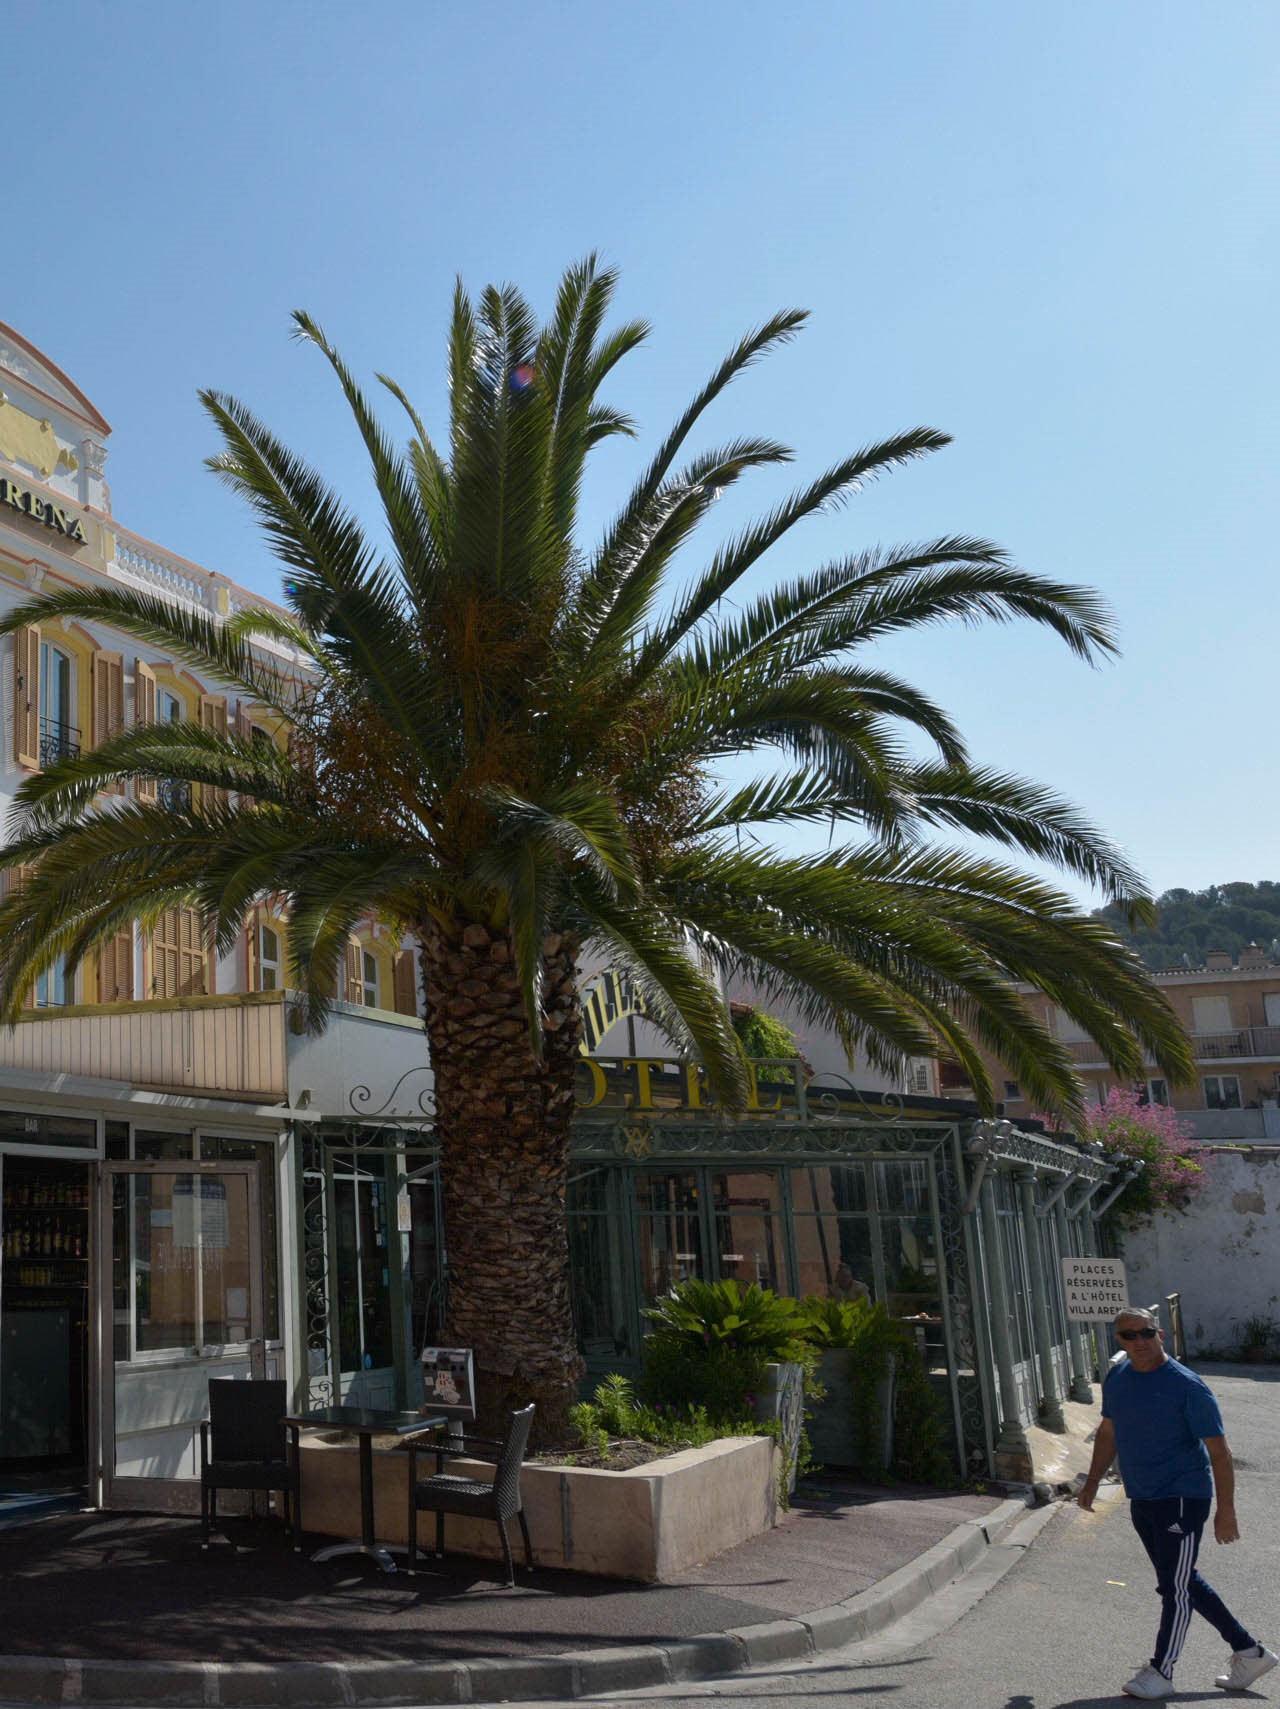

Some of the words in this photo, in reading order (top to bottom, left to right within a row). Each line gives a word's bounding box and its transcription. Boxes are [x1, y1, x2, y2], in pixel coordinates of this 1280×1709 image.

[575, 1057, 783, 1110] OTEL
[1073, 1265, 1114, 1274] PLACES
[1066, 1278, 1124, 1288] RÉSERVÉES
[1081, 1291, 1124, 1301] L'HÔTEL
[1069, 1306, 1095, 1314] VILLA
[1097, 1306, 1125, 1315] AREN
